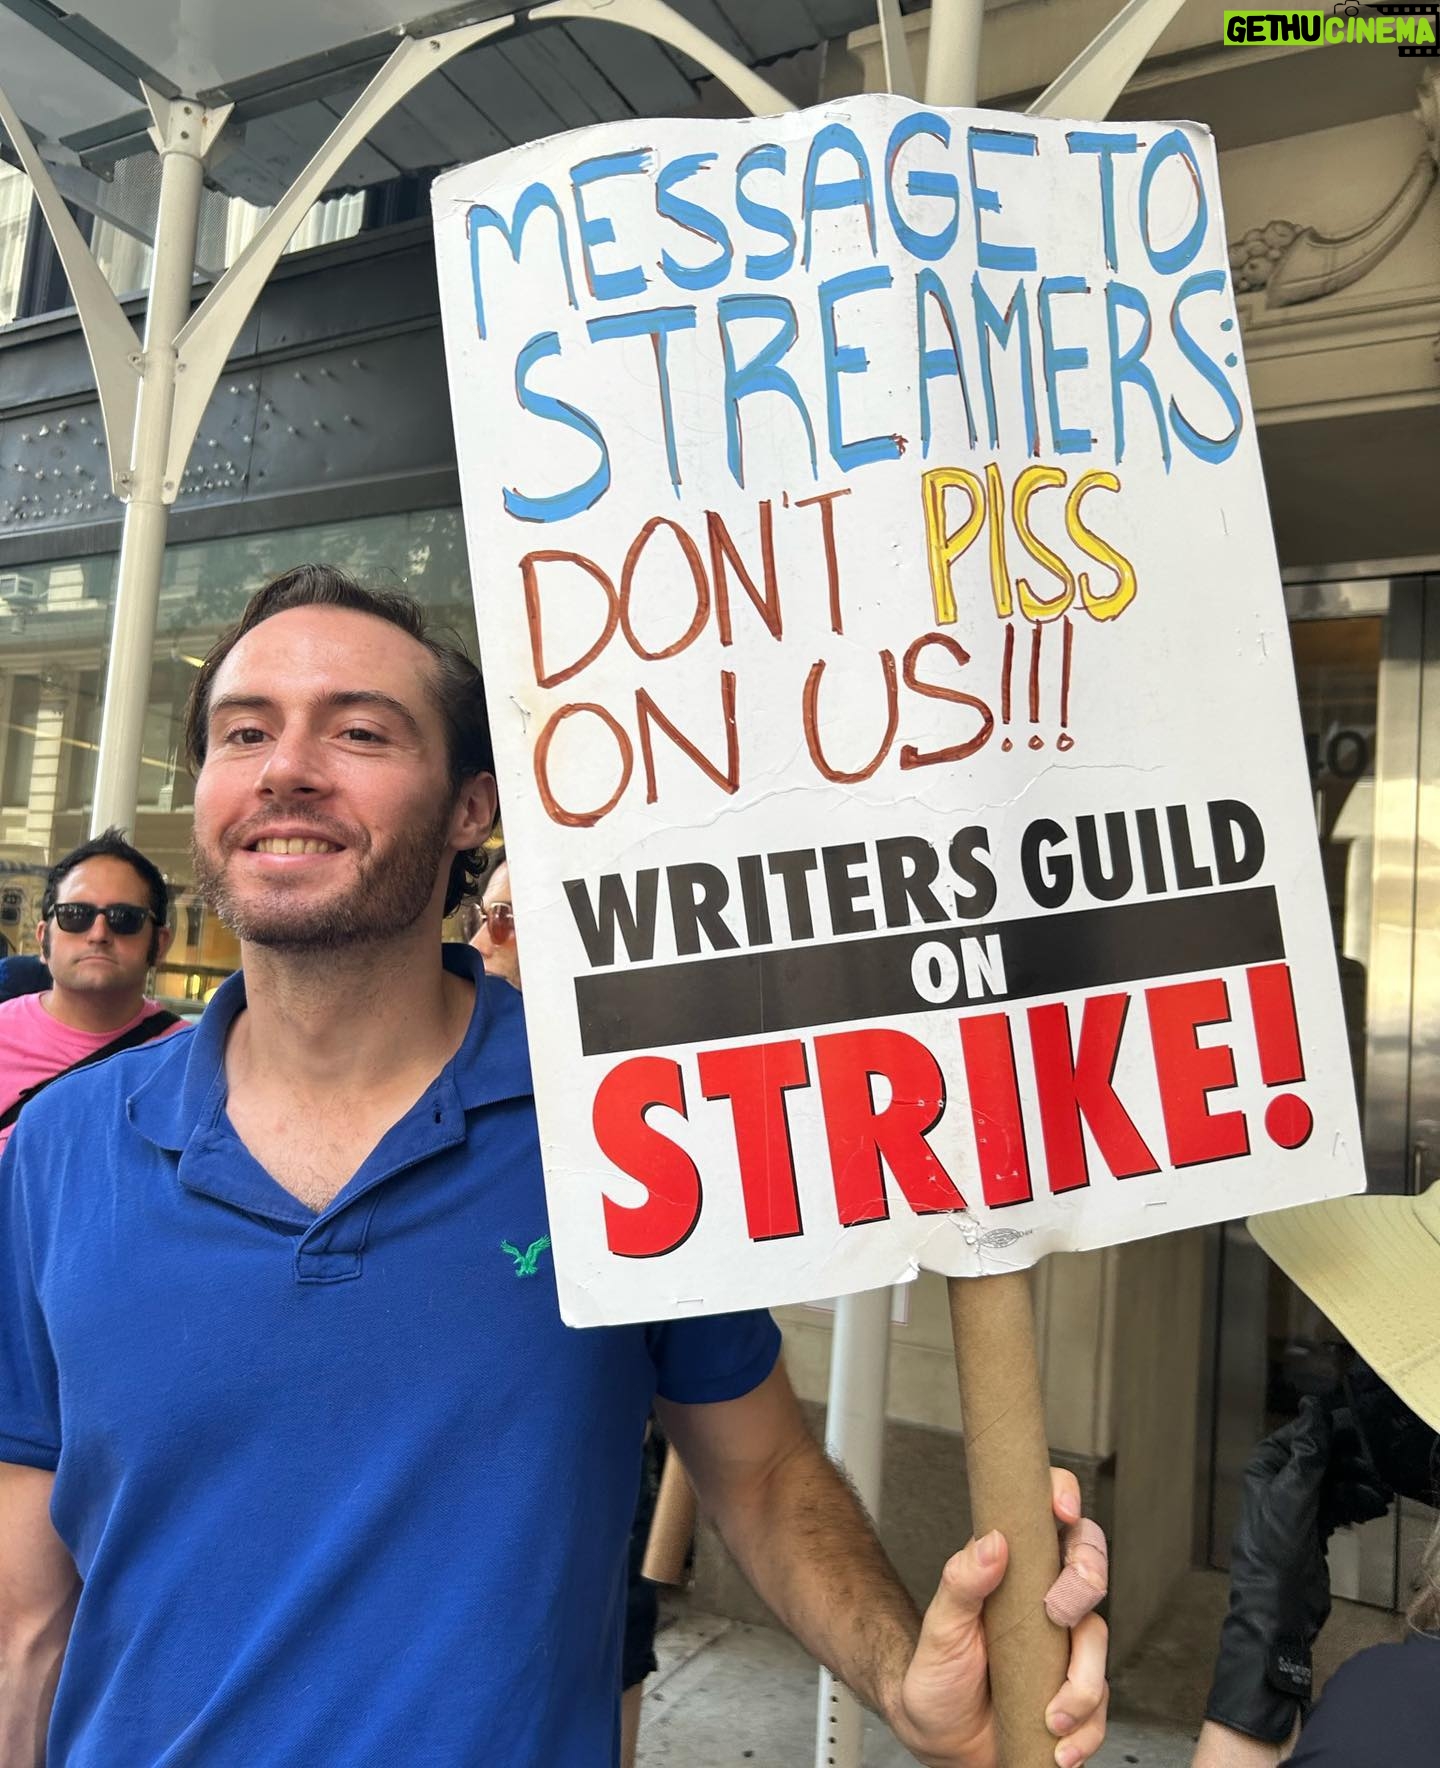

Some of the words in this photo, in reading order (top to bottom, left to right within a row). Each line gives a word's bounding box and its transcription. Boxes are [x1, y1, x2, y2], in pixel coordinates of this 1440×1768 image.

[466, 112, 1039, 340] MESSAGE
[1066, 129, 1208, 275] TO
[502, 266, 1243, 523] STREAMERS:
[518, 489, 852, 688] DON'T
[922, 463, 1137, 626] PISS
[534, 670, 739, 827] ON
[802, 615, 1075, 784] US!!!
[562, 825, 998, 967] WRITERS
[1020, 798, 1266, 909] GUILD
[911, 934, 1008, 1004] ON
[592, 962, 1314, 1258] STRIKE!
